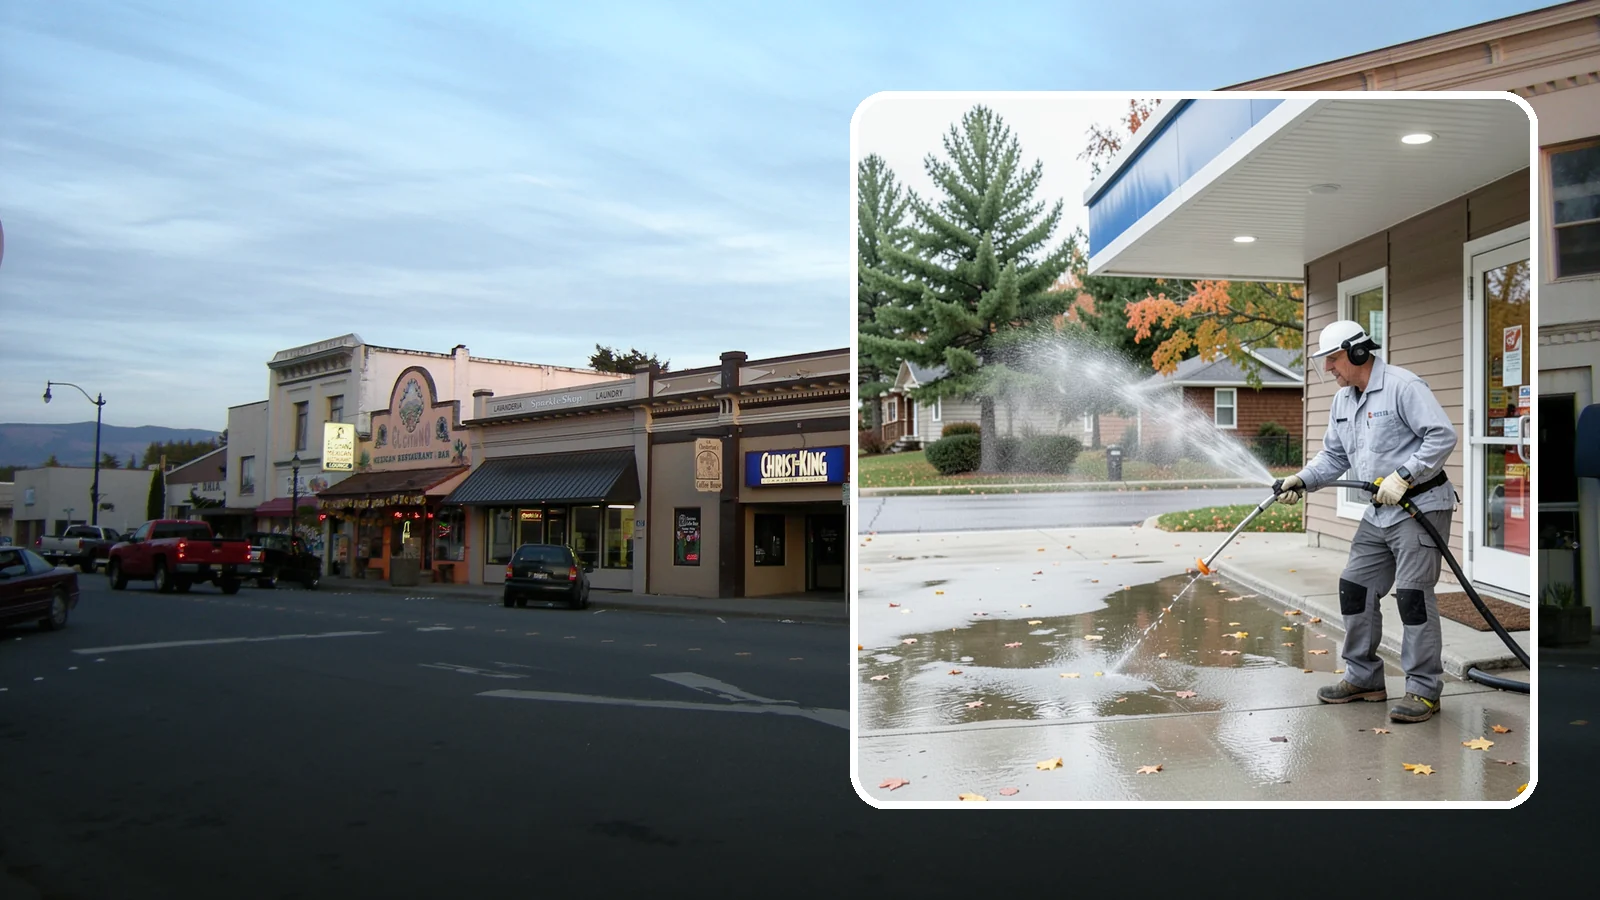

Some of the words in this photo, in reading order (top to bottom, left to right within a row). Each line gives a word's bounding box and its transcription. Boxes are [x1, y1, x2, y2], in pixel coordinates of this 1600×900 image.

[493, 402, 523, 413] LAVANDERIA
[561, 394, 583, 404] Shop
[595, 388, 624, 400] LAUNDRY
[397, 451, 434, 462] RESTAURANT
[437, 450, 450, 459] BAR
